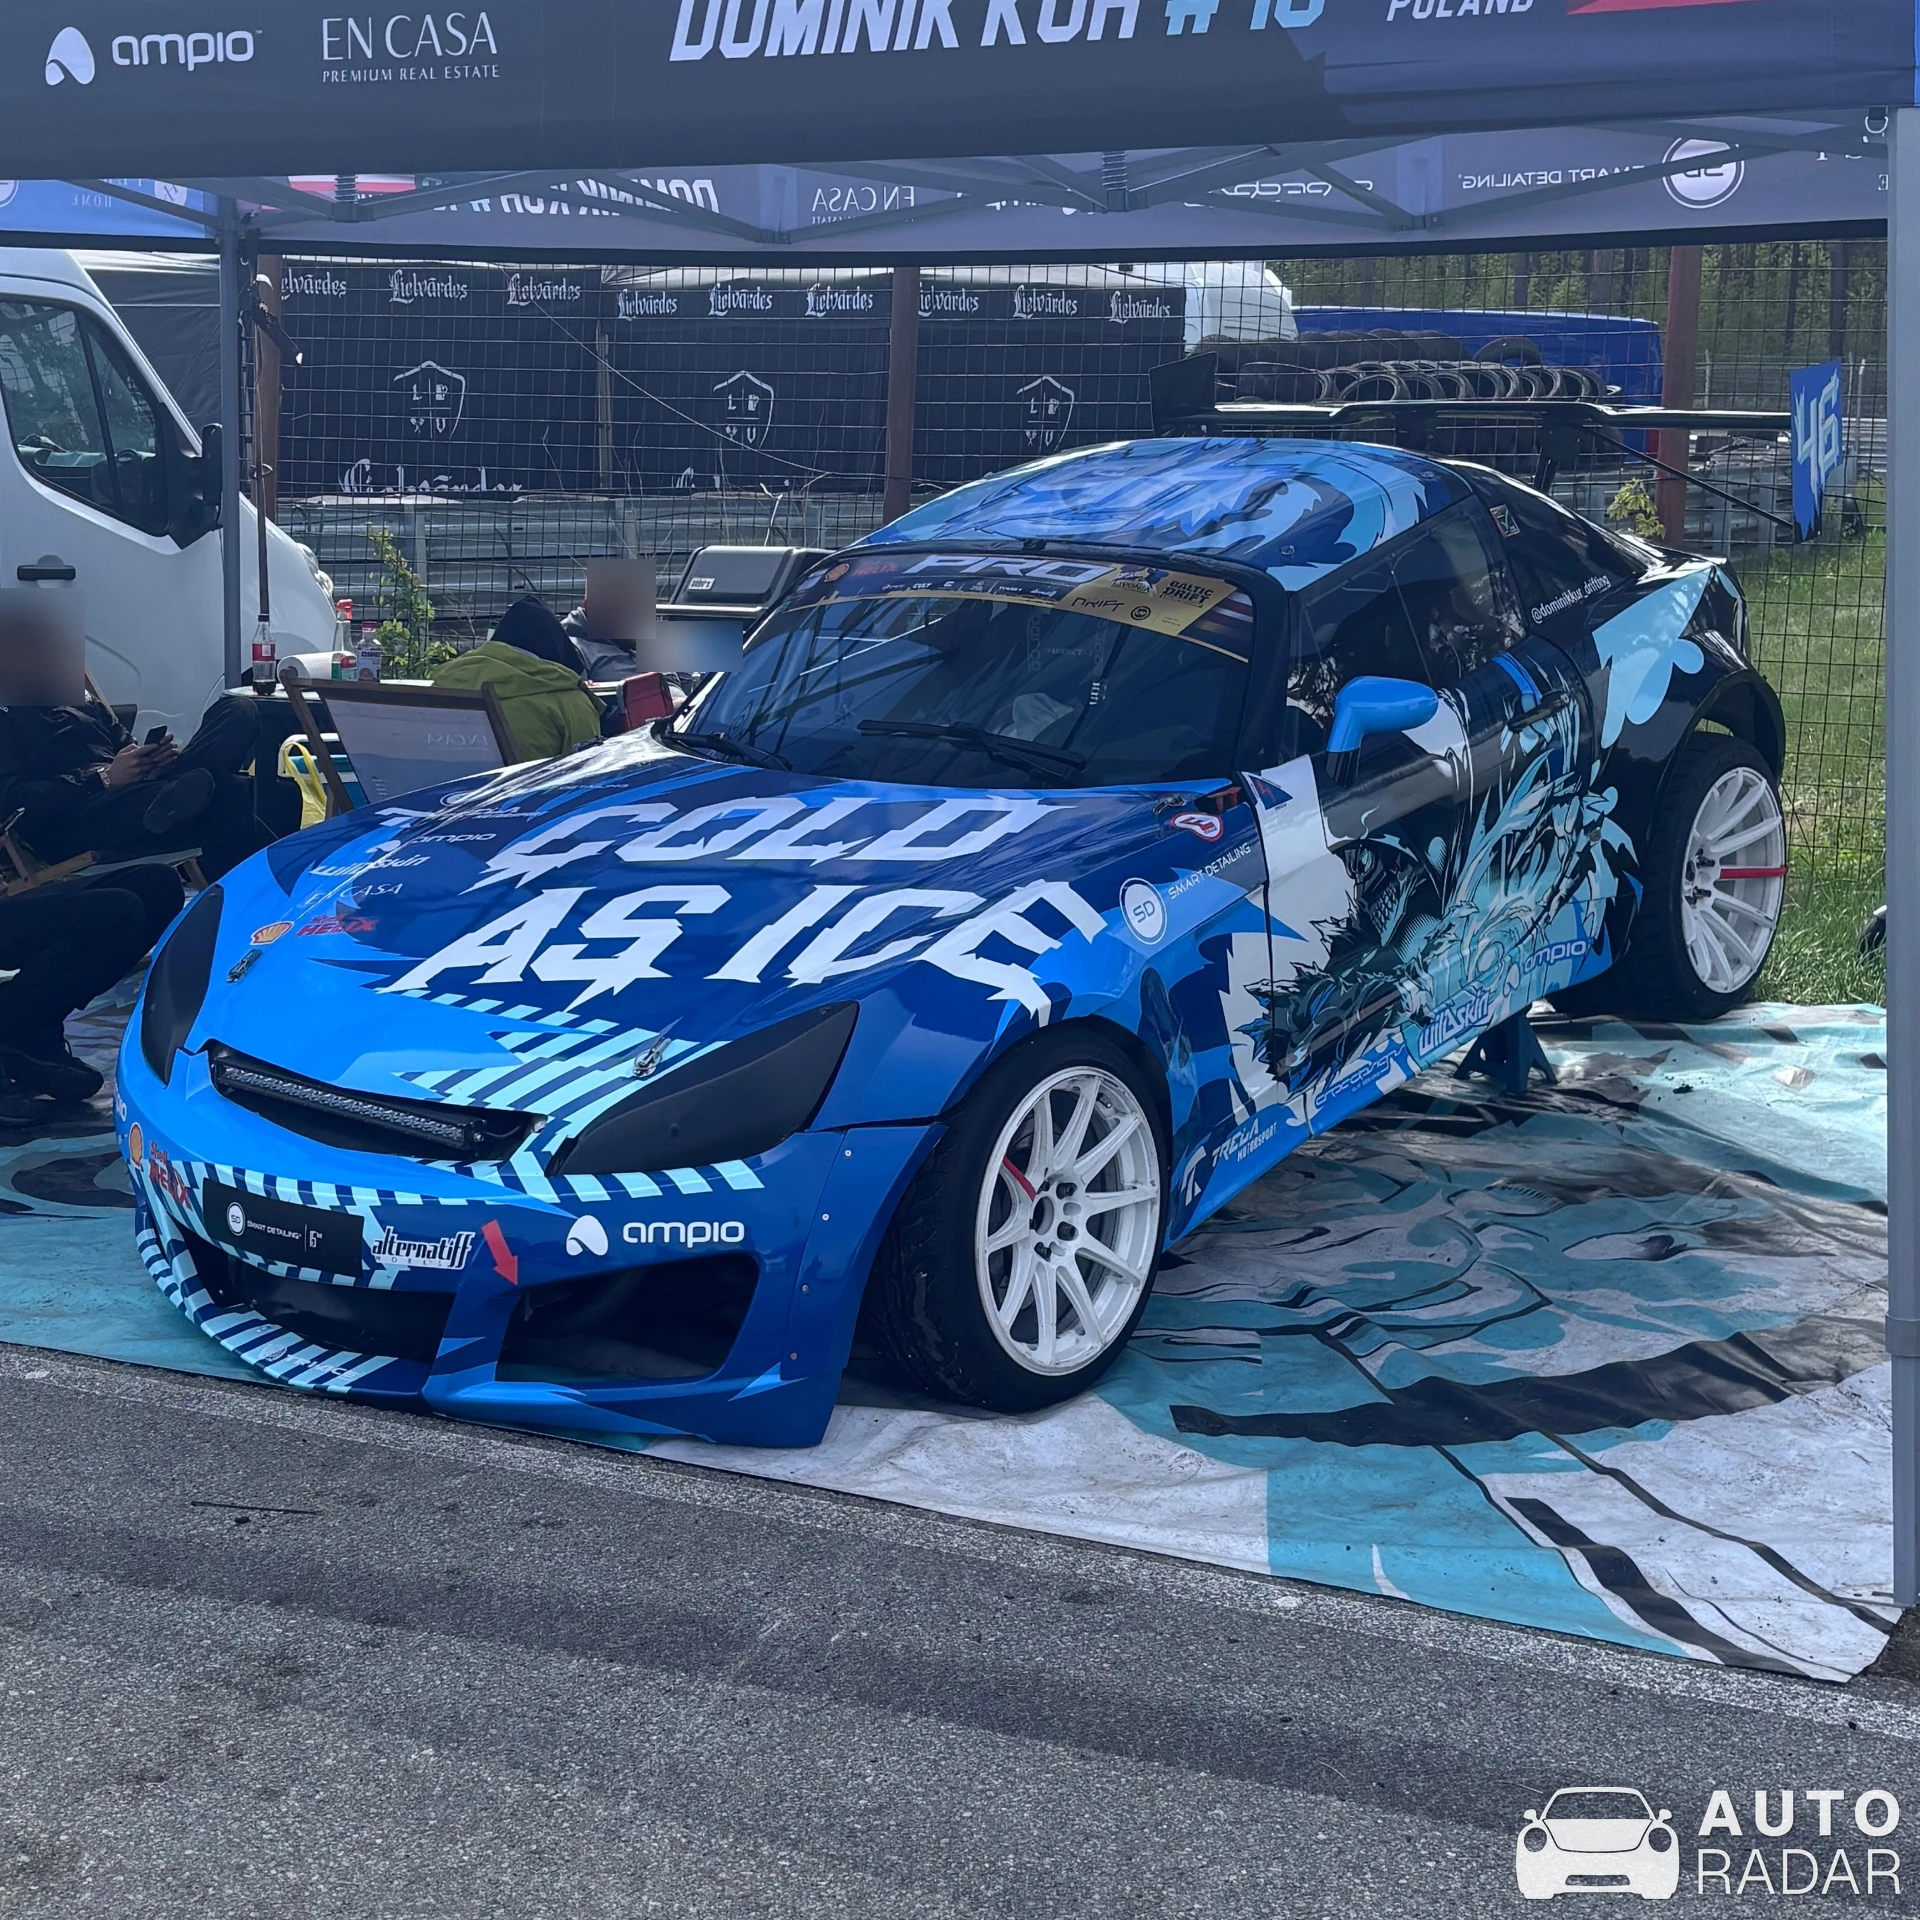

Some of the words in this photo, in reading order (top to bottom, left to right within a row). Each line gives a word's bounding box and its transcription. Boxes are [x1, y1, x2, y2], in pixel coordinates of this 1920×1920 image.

[322, 16, 373, 61] EN
[385, 11, 498, 59] CASA
[669, 0, 960, 61] DOMINIK
[112, 30, 254, 71] ampio
[322, 68, 392, 83] PREMIUM
[399, 66, 438, 81] REAL
[444, 64, 500, 79] ESTATE
[901, 554, 1115, 584] PRO
[1160, 587, 1210, 605] DRIFT
[1169, 580, 1214, 597] BALTIC
[458, 795, 1079, 896] COLD
[1167, 869, 1205, 900] SMART
[1204, 842, 1252, 877] DETAILING
[1132, 900, 1156, 924] SD
[372, 885, 732, 1012] AS
[703, 879, 1108, 1028] ICE
[1523, 940, 1588, 973] ampio
[1237, 1121, 1277, 1162] MOTORSPORT
[230, 1214, 241, 1224] SD
[246, 1219, 266, 1232] SMART
[623, 1221, 745, 1248] ampio
[372, 1226, 476, 1269] alternatiff
